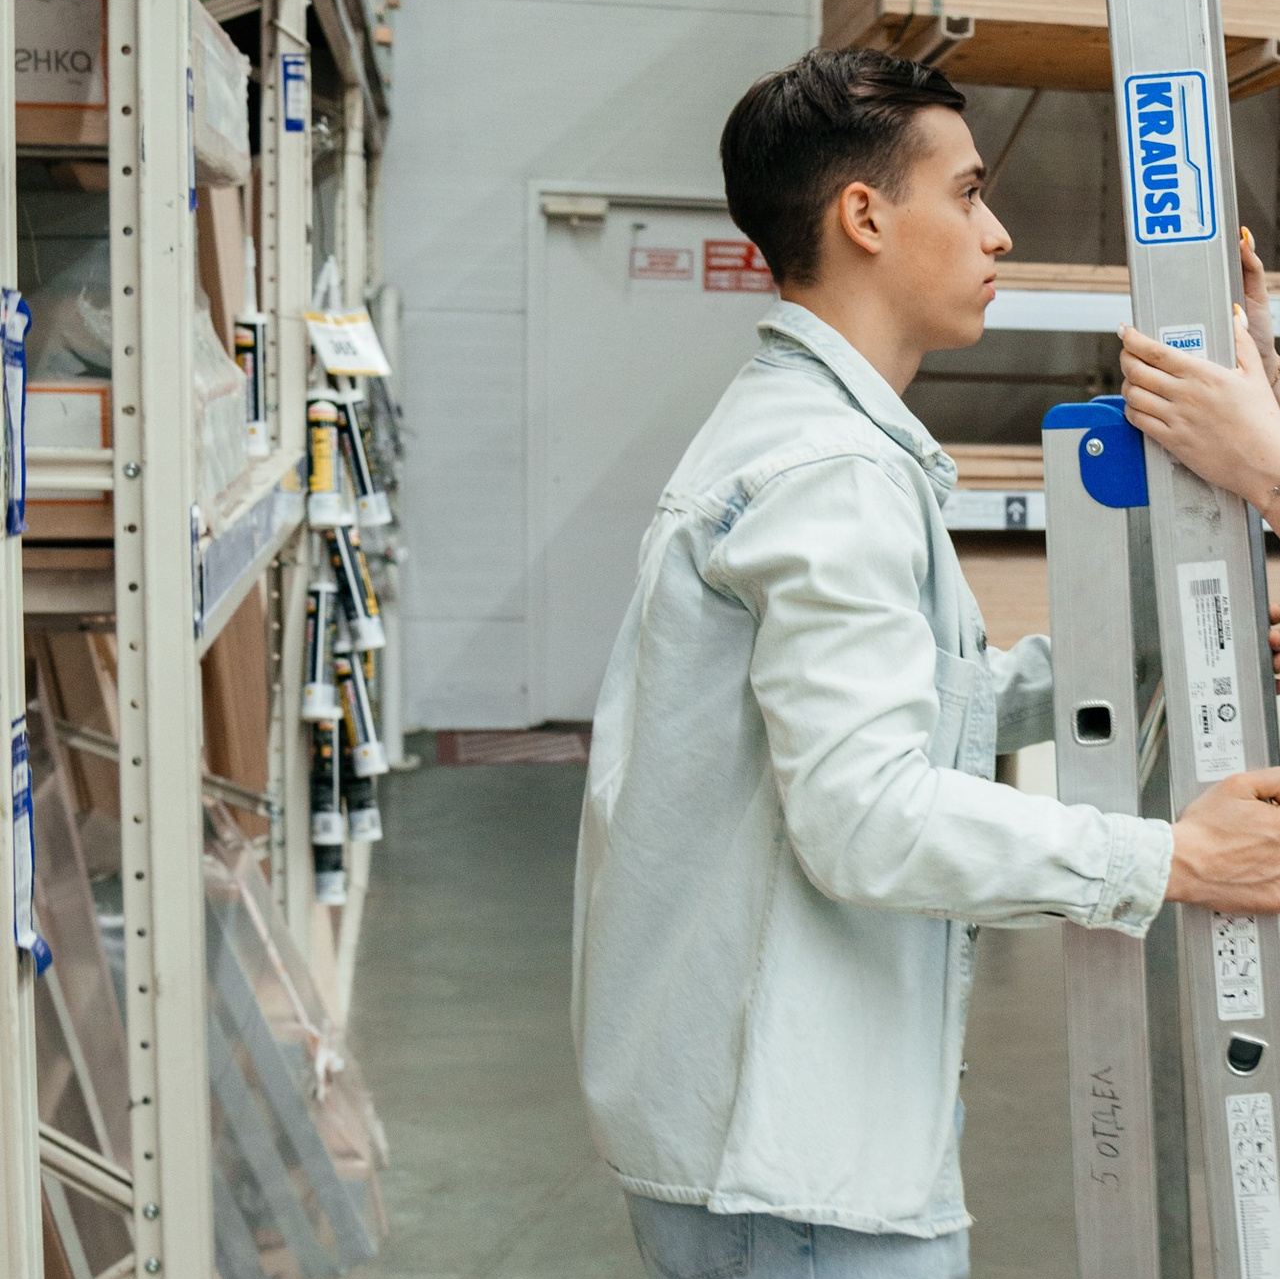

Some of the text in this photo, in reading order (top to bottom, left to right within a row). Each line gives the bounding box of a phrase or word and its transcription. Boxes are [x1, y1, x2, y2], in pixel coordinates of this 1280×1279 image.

[1135, 81, 1182, 236] KRAUSE
[1090, 1065, 1125, 1192] 5 ОТДЕЛ
